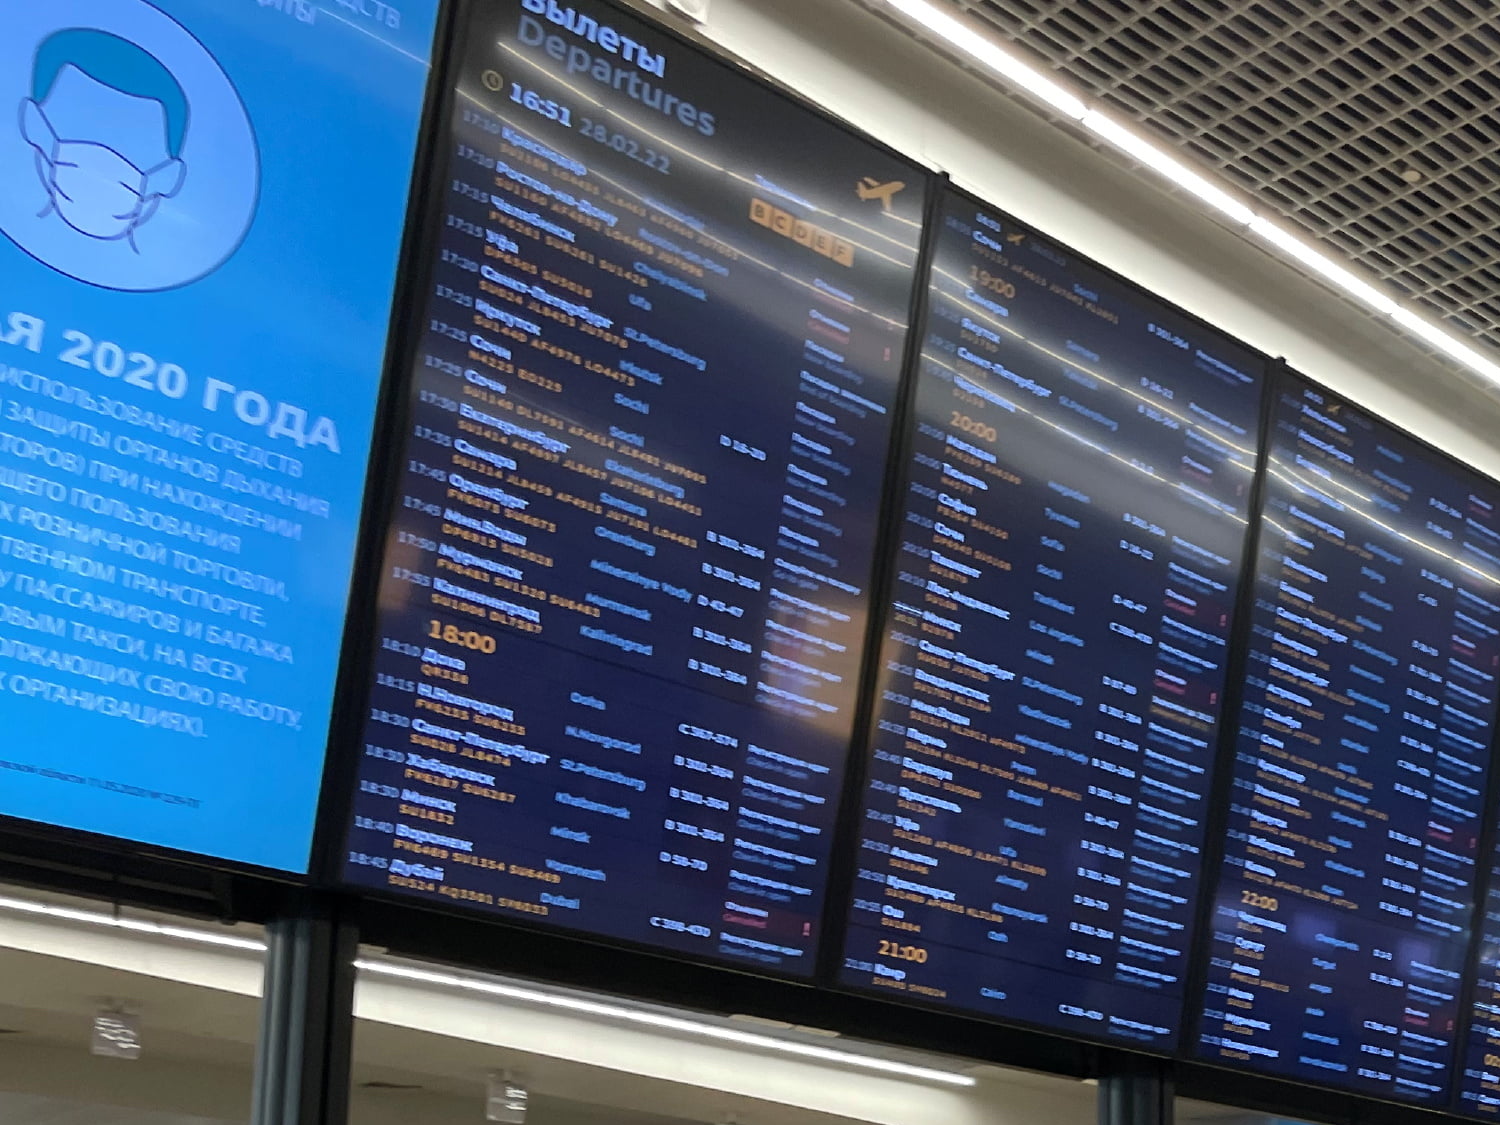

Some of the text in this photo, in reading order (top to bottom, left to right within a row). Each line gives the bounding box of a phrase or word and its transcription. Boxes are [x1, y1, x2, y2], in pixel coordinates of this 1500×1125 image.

[517, 14, 716, 137] Departures
[509, 82, 671, 175] 16:51 28.02.22
[968, 262, 1016, 301] 19:00
[0, 311, 341, 454] Я 2020 ГОДА
[5, 400, 111, 449] ЗАЩИТЫ
[114, 435, 219, 483] ОРГАНОВ
[950, 409, 997, 445] 20:00
[88, 460, 139, 488] ПРИ
[206, 431, 304, 479] СРЕДСТВ
[152, 643, 187, 669] НА
[428, 617, 497, 656] 18:00
[877, 938, 928, 965] 21:00
